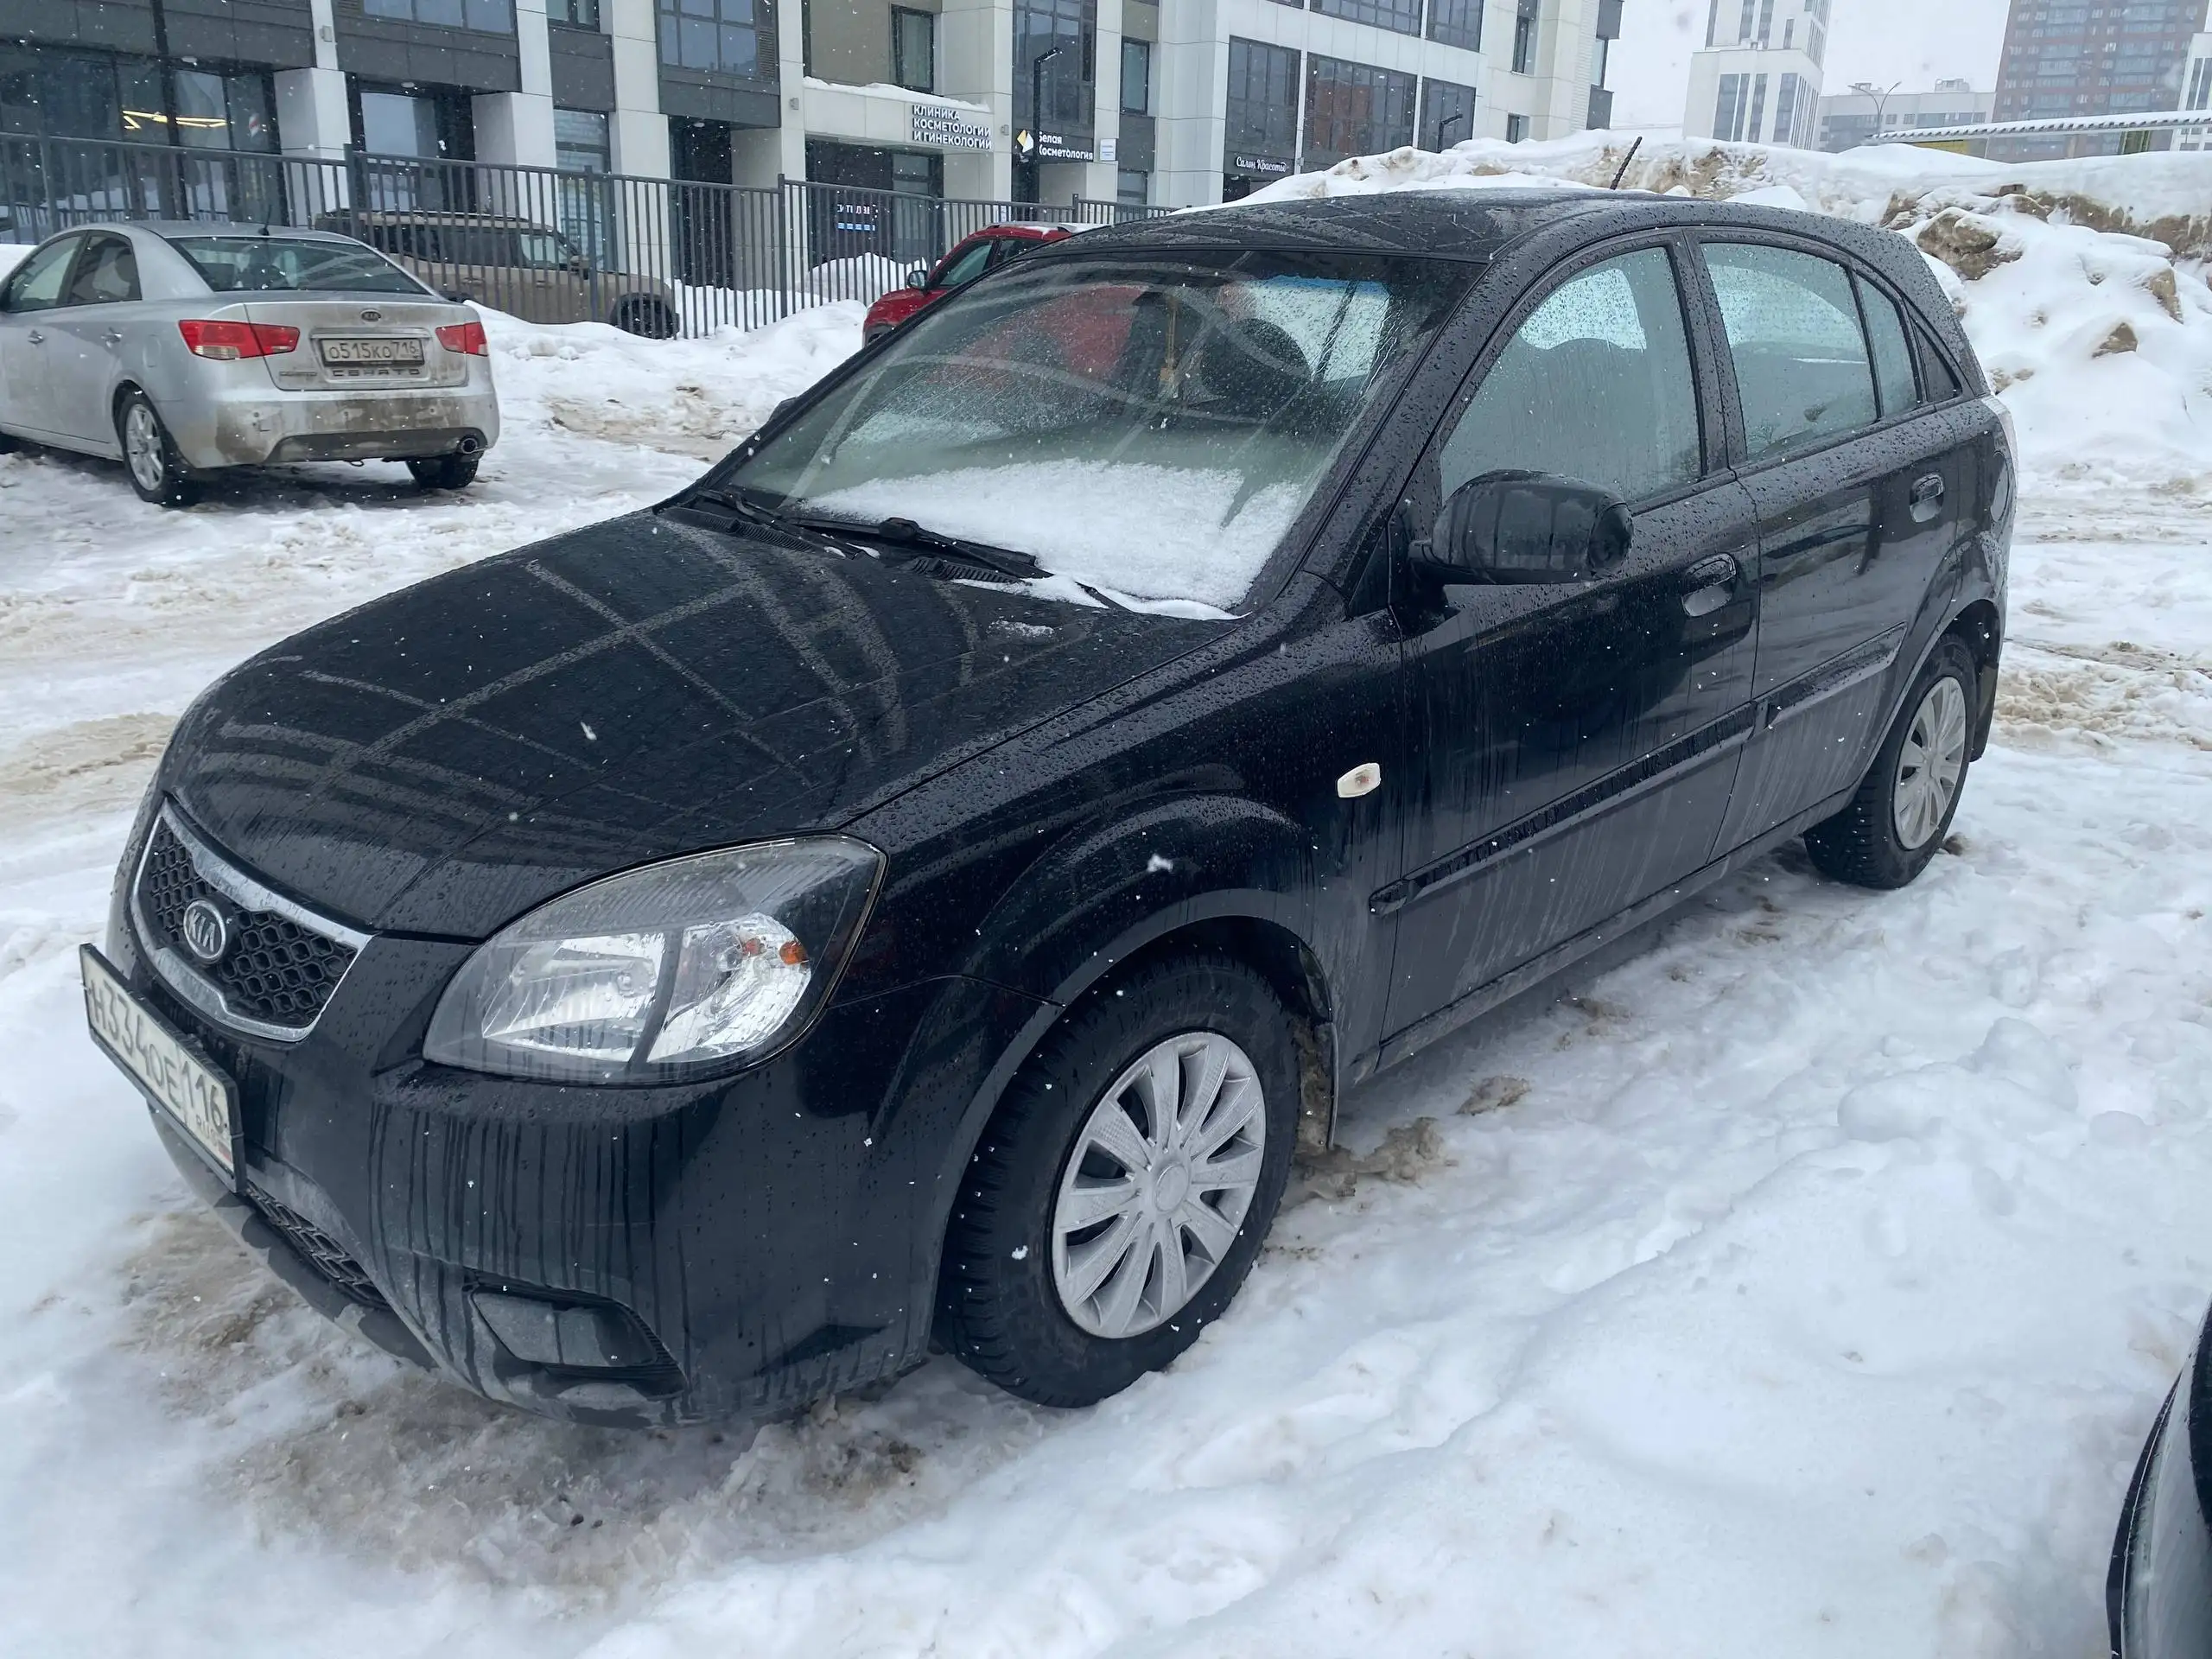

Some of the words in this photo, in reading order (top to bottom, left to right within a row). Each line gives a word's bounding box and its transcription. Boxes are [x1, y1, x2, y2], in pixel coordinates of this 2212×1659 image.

[912, 105, 961, 121] КЛИНИКА
[912, 118, 991, 137] КОСМЕТОЛОГИИ
[913, 130, 921, 141] И
[923, 132, 992, 149] ГИНЕКОЛОГИИ
[186, 906, 218, 954] KIA
